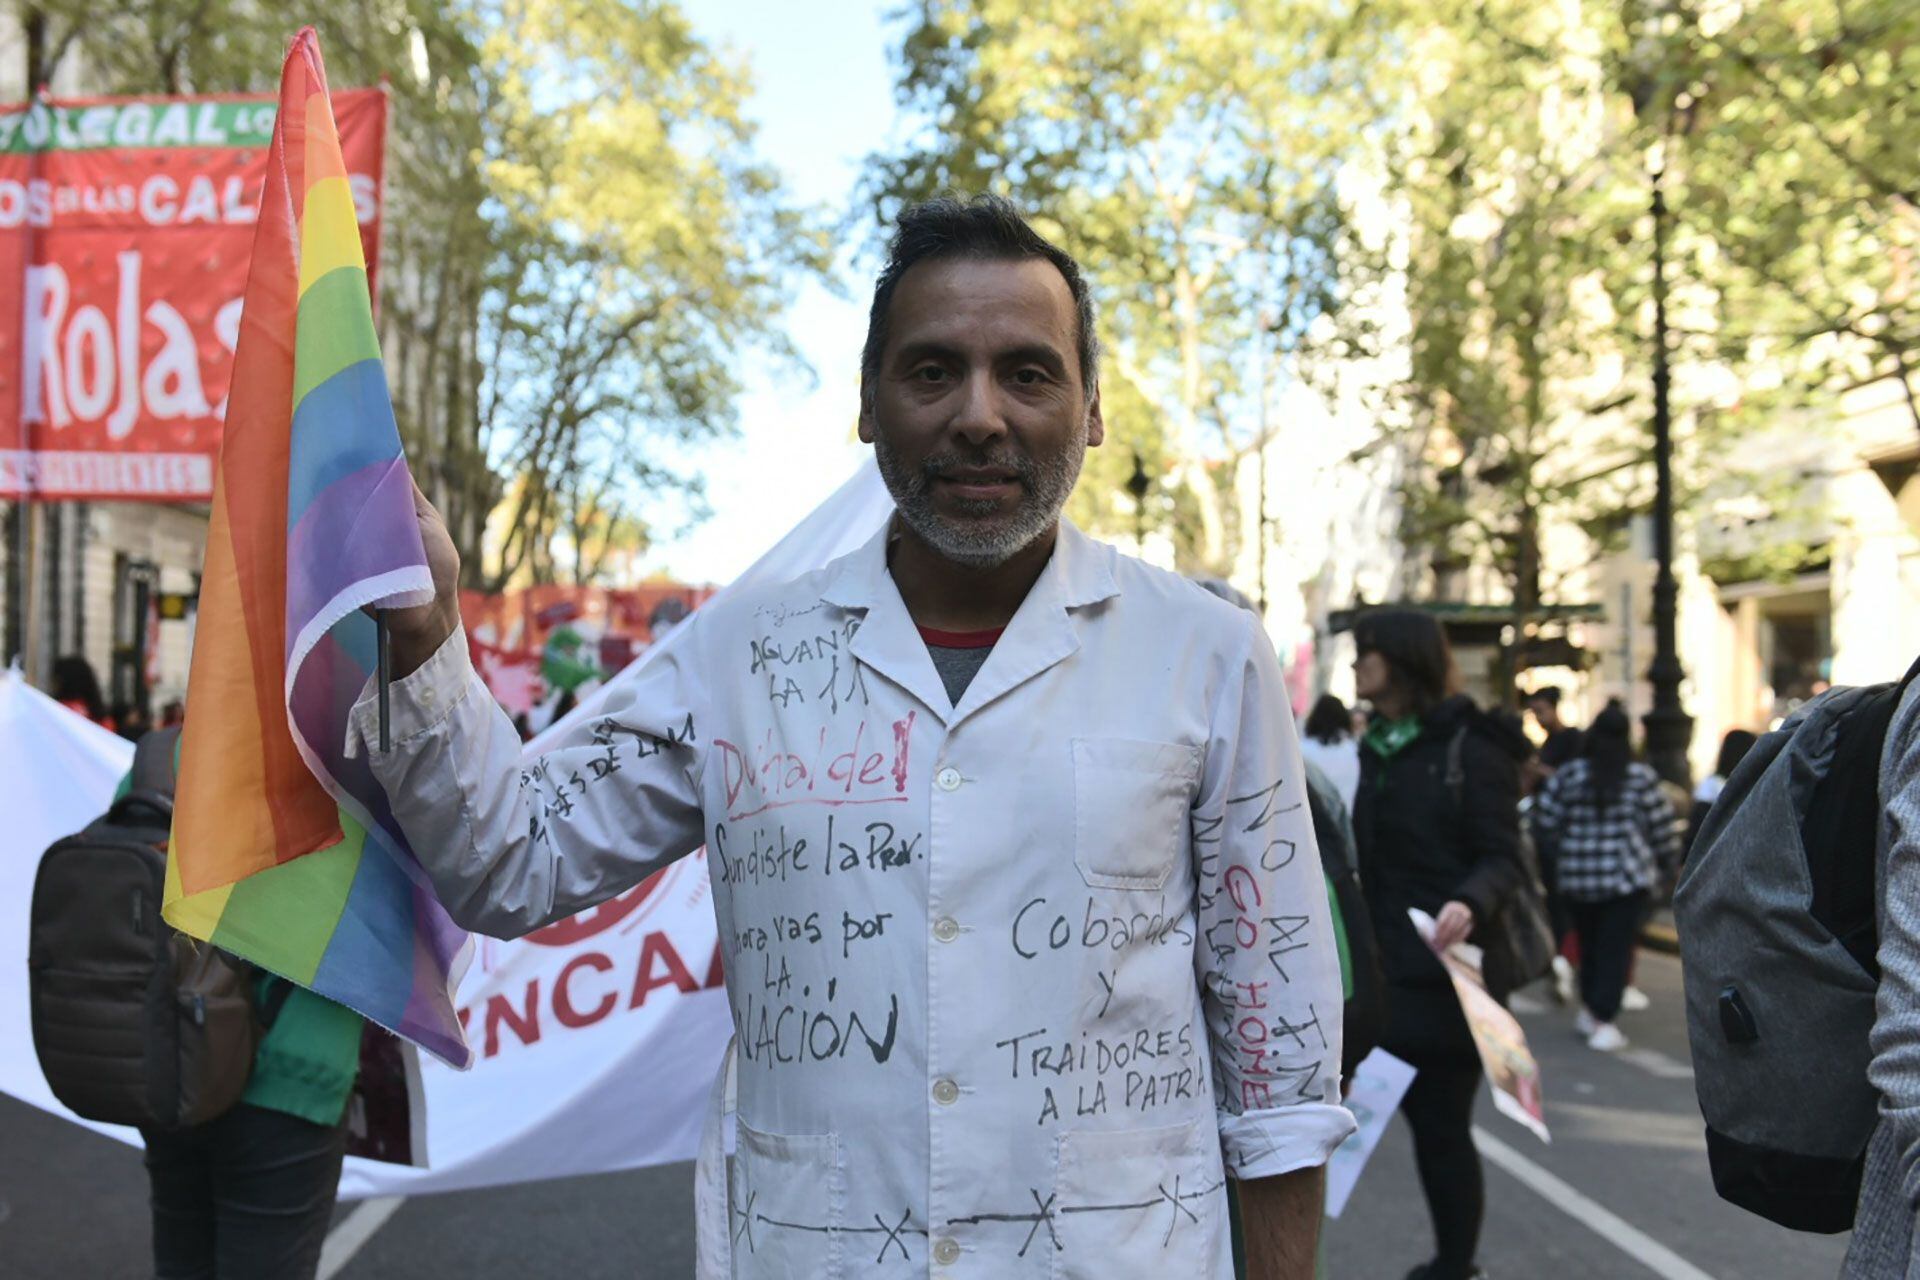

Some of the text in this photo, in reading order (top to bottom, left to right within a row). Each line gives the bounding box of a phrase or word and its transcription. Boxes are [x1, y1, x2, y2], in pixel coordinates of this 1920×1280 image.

[55, 102, 227, 149] LEGAL
[139, 173, 377, 226] CALS
[1226, 779, 1302, 872] NO
[842, 910, 894, 959] por
[1224, 865, 1262, 949] GO
[1261, 916, 1309, 983] AL
[456, 927, 724, 1059] NCA
[1236, 981, 1273, 1109] HOME
[1037, 1086, 1059, 1126] A
[1076, 1079, 1107, 1117] LA
